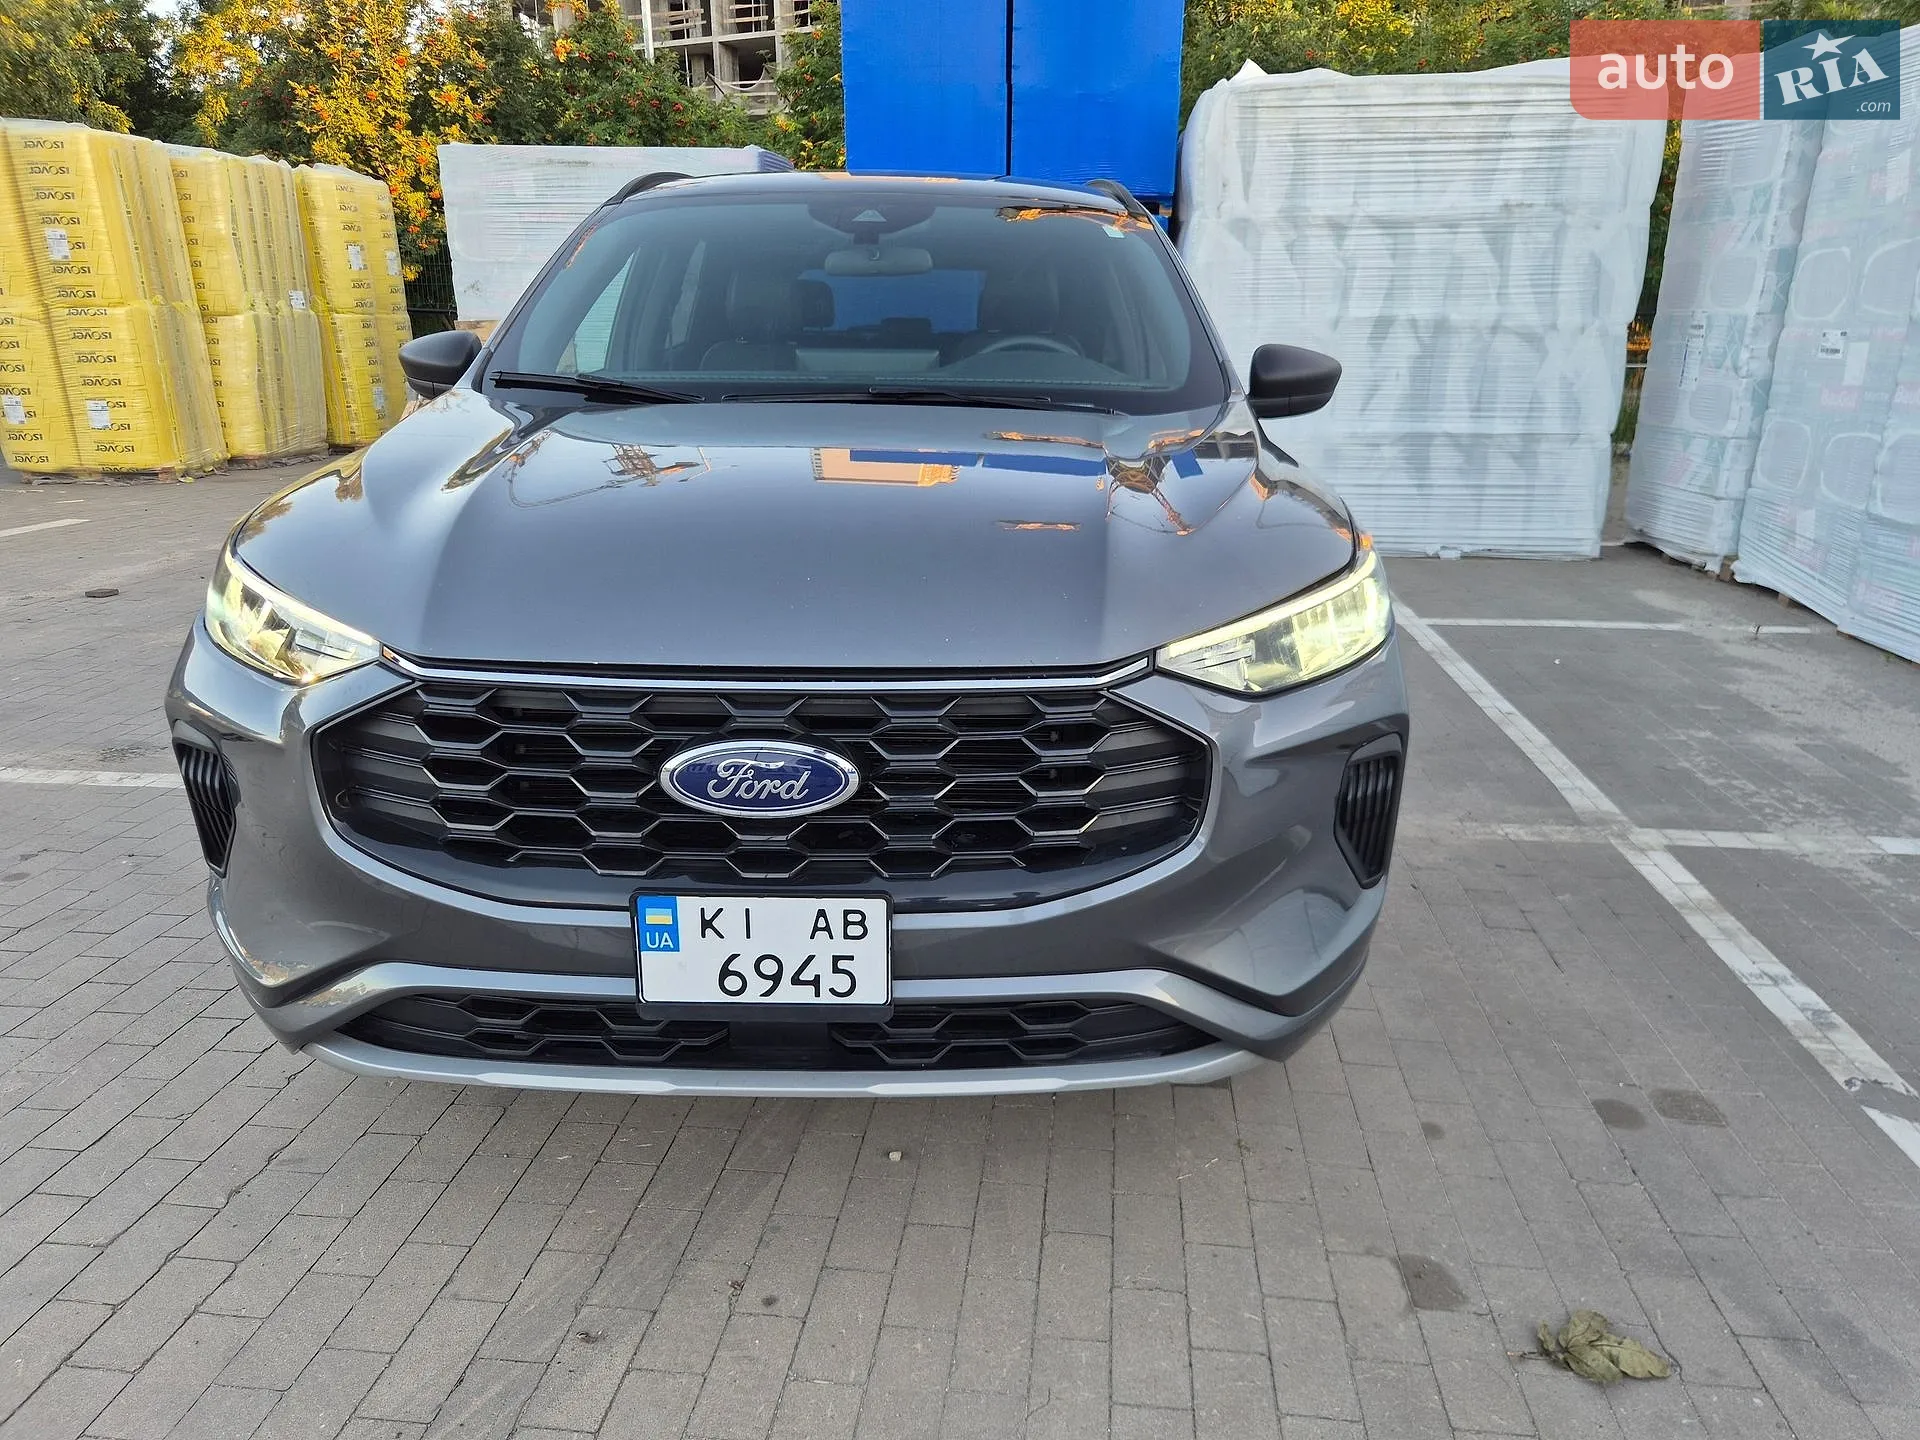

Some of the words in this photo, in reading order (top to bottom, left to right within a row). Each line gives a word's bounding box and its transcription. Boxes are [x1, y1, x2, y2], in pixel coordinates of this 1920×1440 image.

[707, 759, 811, 800] Ford
[646, 932, 673, 949] UA
[700, 907, 752, 940] KI
[810, 909, 868, 941] AB
[717, 953, 857, 998] 6945
